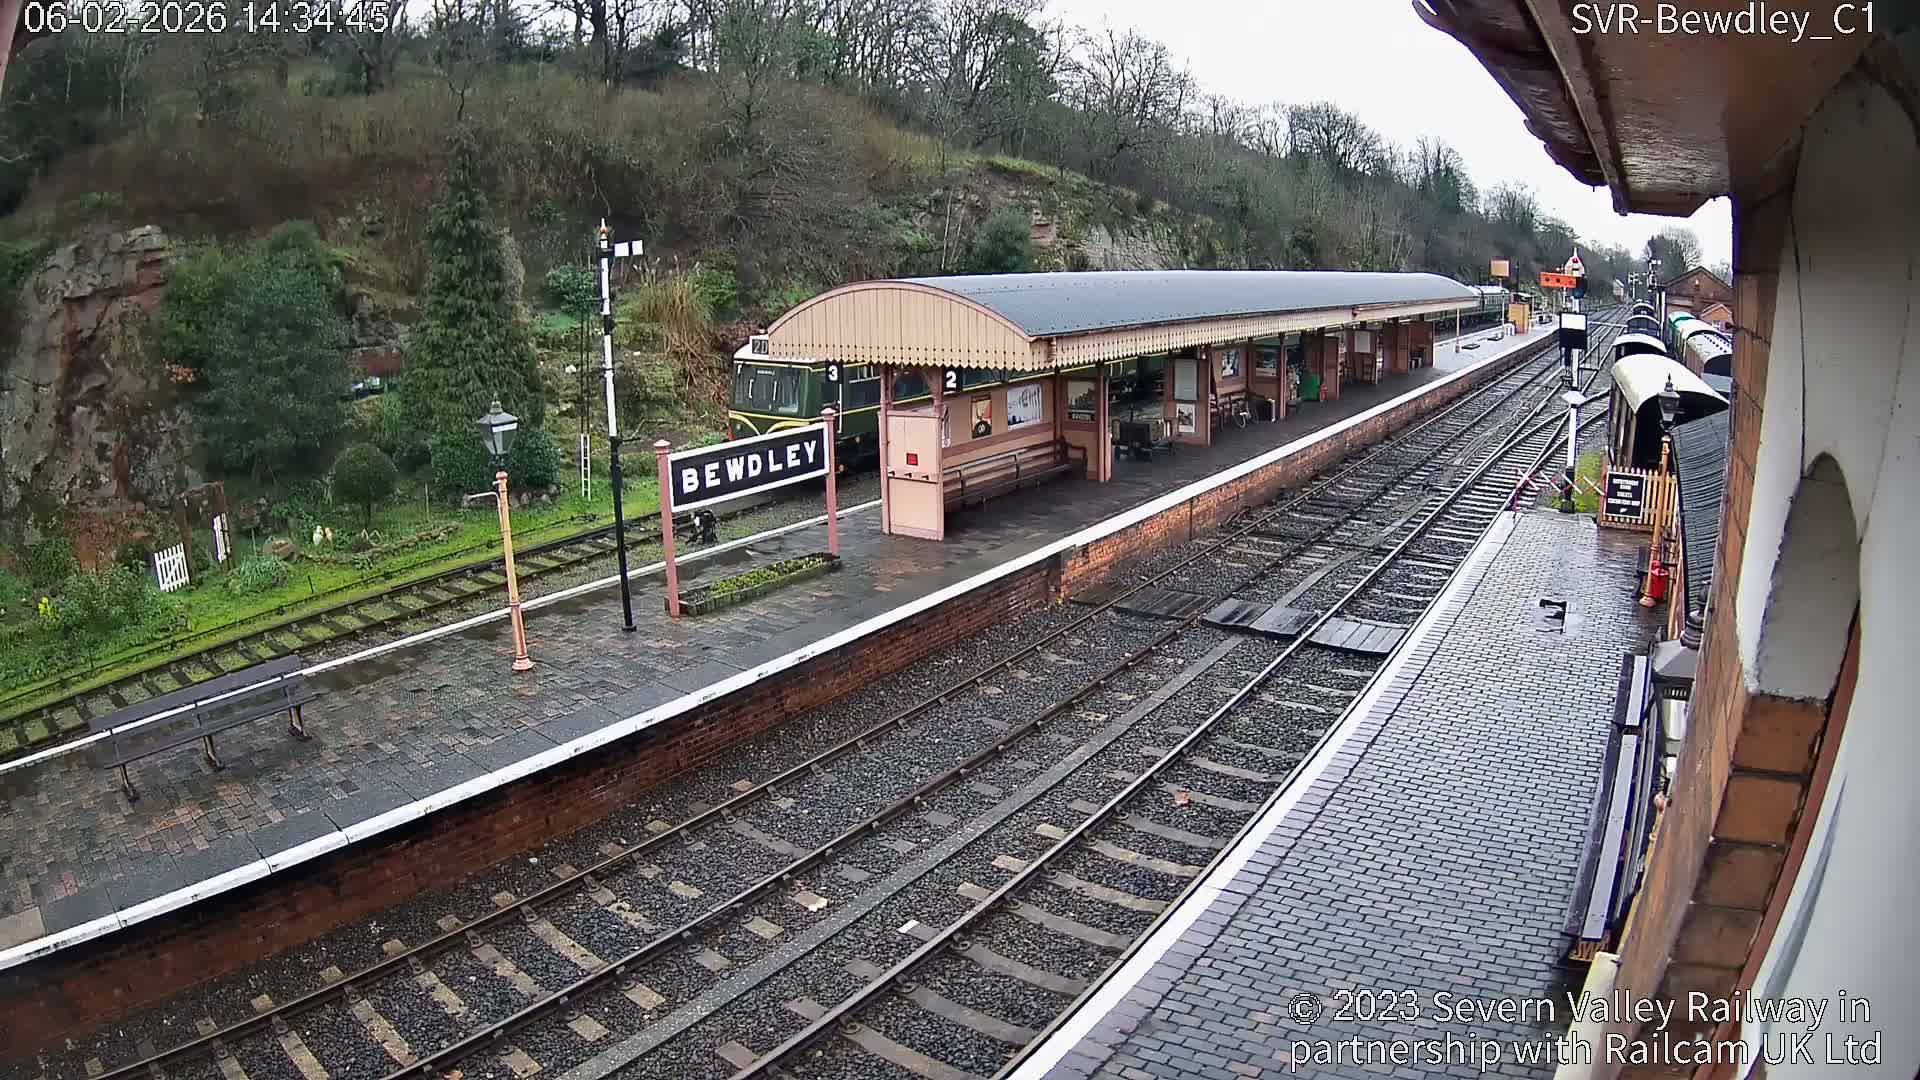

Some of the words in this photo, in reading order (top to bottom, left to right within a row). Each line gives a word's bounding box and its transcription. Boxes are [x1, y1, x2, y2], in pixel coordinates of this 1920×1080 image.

[828, 365, 839, 381] 3
[945, 371, 957, 388] 2
[682, 440, 817, 494] BEWDLEY
